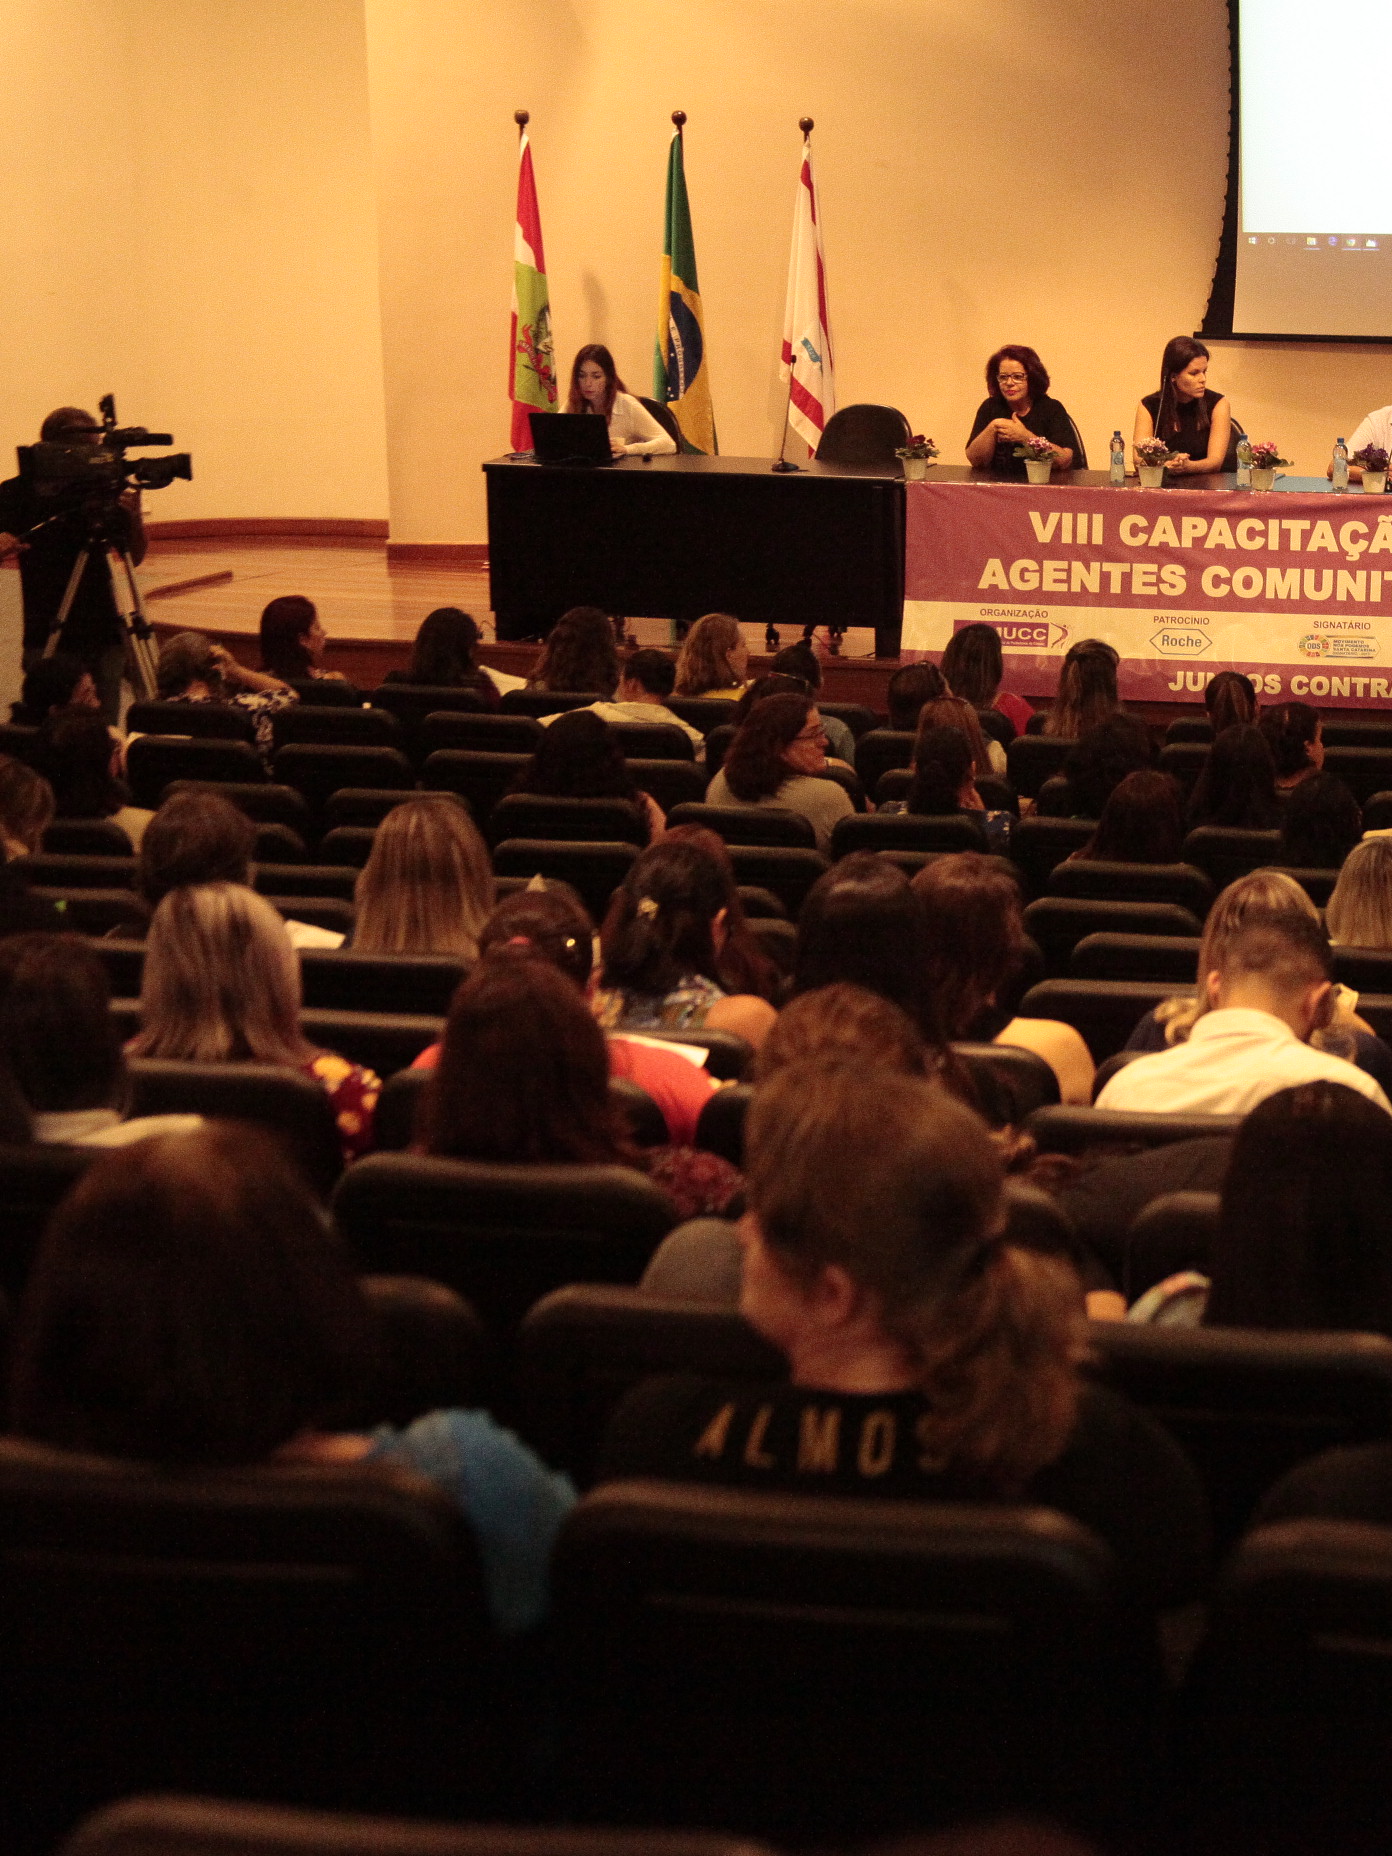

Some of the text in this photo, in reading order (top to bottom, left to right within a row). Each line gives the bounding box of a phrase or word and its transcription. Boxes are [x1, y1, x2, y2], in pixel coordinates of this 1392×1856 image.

[1029, 512, 1103, 544] VIII
[979, 559, 1186, 596] AGENTES
[979, 608, 1049, 619] ORGANIZAÇÃO
[1153, 615, 1210, 626] PATROCÍNIO
[1313, 620, 1371, 630] SIGNATÁRIO
[997, 626, 1047, 640] UCC
[1161, 634, 1202, 648] Roche
[1307, 642, 1321, 650] ODS
[1168, 671, 1282, 694] JUOS
